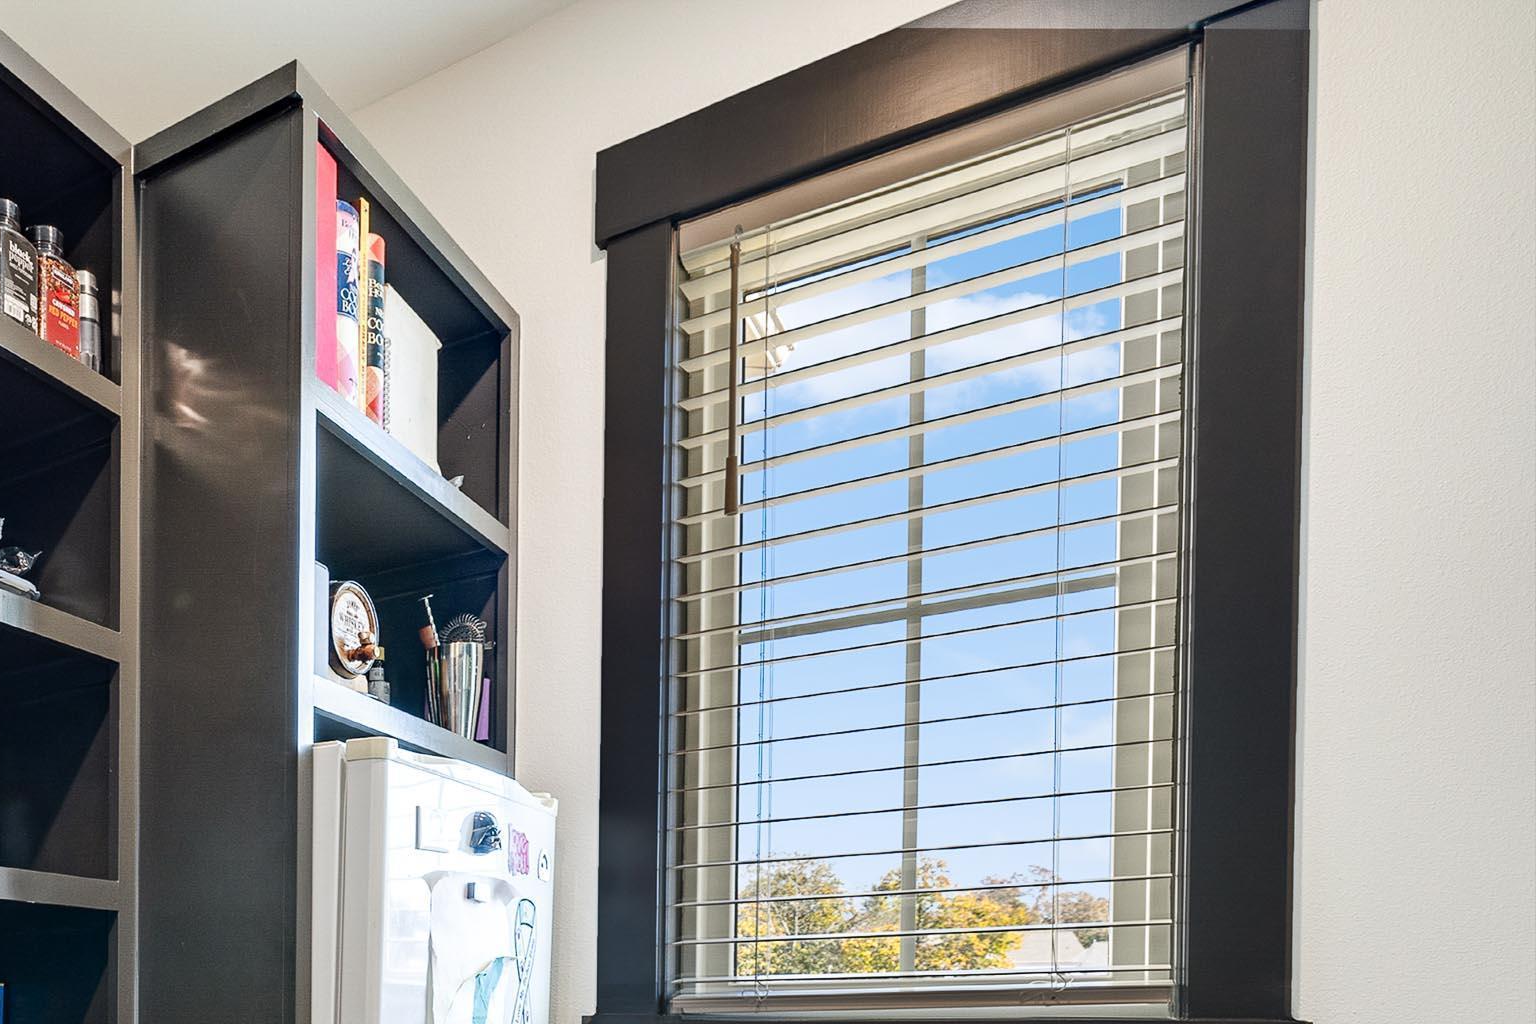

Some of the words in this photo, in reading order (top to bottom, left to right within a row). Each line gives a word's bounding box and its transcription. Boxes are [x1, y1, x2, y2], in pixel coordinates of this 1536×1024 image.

[8, 250, 35, 273] pepper
[9, 240, 33, 264] black
[59, 311, 78, 330] PEPPER
